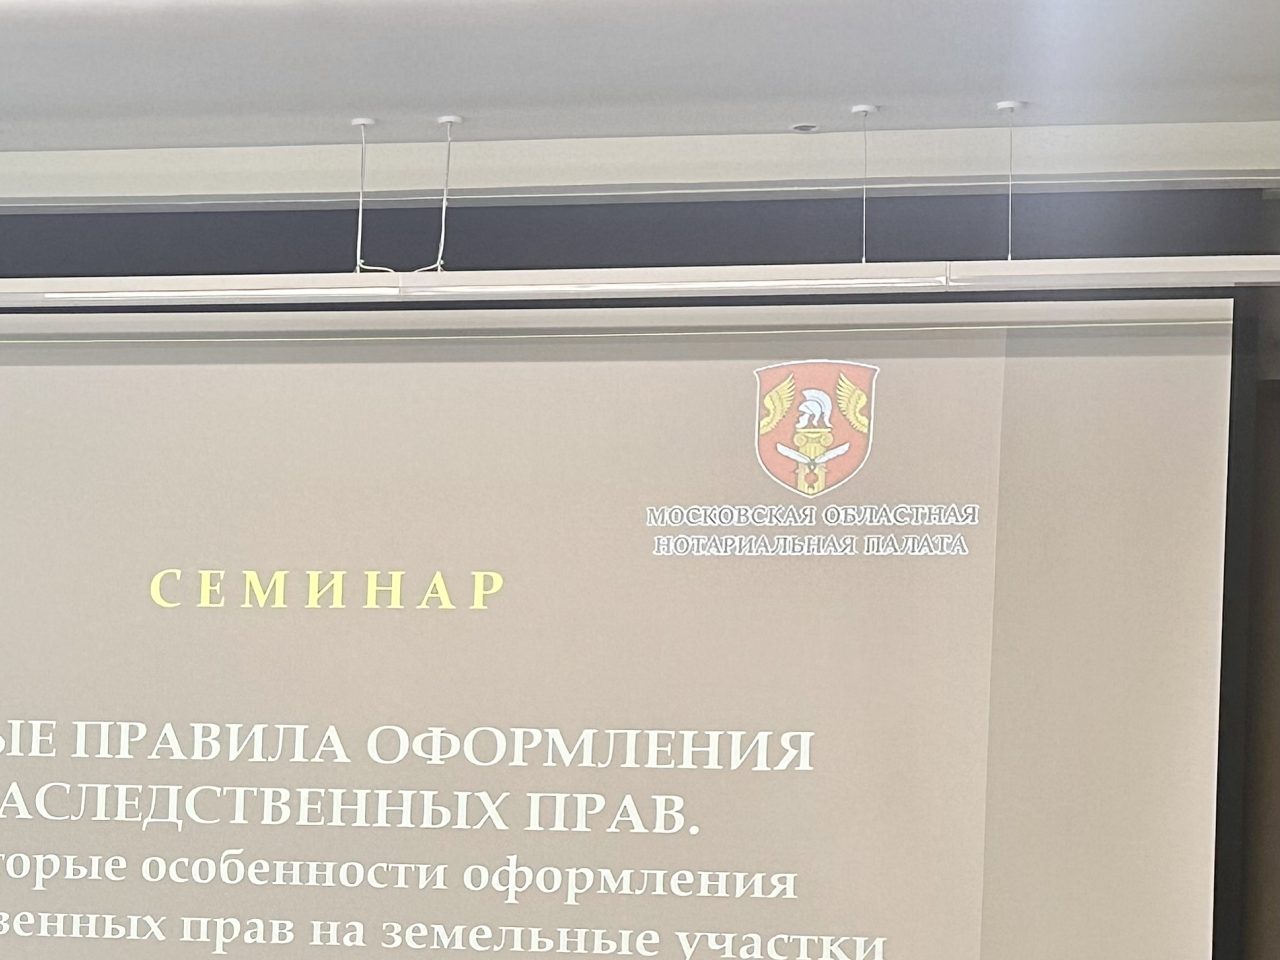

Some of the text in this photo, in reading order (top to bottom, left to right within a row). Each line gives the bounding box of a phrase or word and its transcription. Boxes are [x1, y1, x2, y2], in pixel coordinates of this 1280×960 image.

[646, 503, 980, 527] МОСКОВСКАЯ ОБЛАСТНАЯ
[652, 534, 969, 556] НОТАРИАЛЬНАЯ ПАЛАТА
[149, 568, 504, 610] СЕМИНАР
[71, 720, 352, 764] ПРАВИЛА
[366, 724, 815, 772] ОФОРМЛЕНИЯ
[525, 792, 701, 836] ПРАВ.
[141, 848, 448, 890] особенности
[462, 855, 799, 905] оформления
[179, 916, 295, 955] прав
[308, 920, 367, 948] на
[381, 921, 661, 958] земельные
